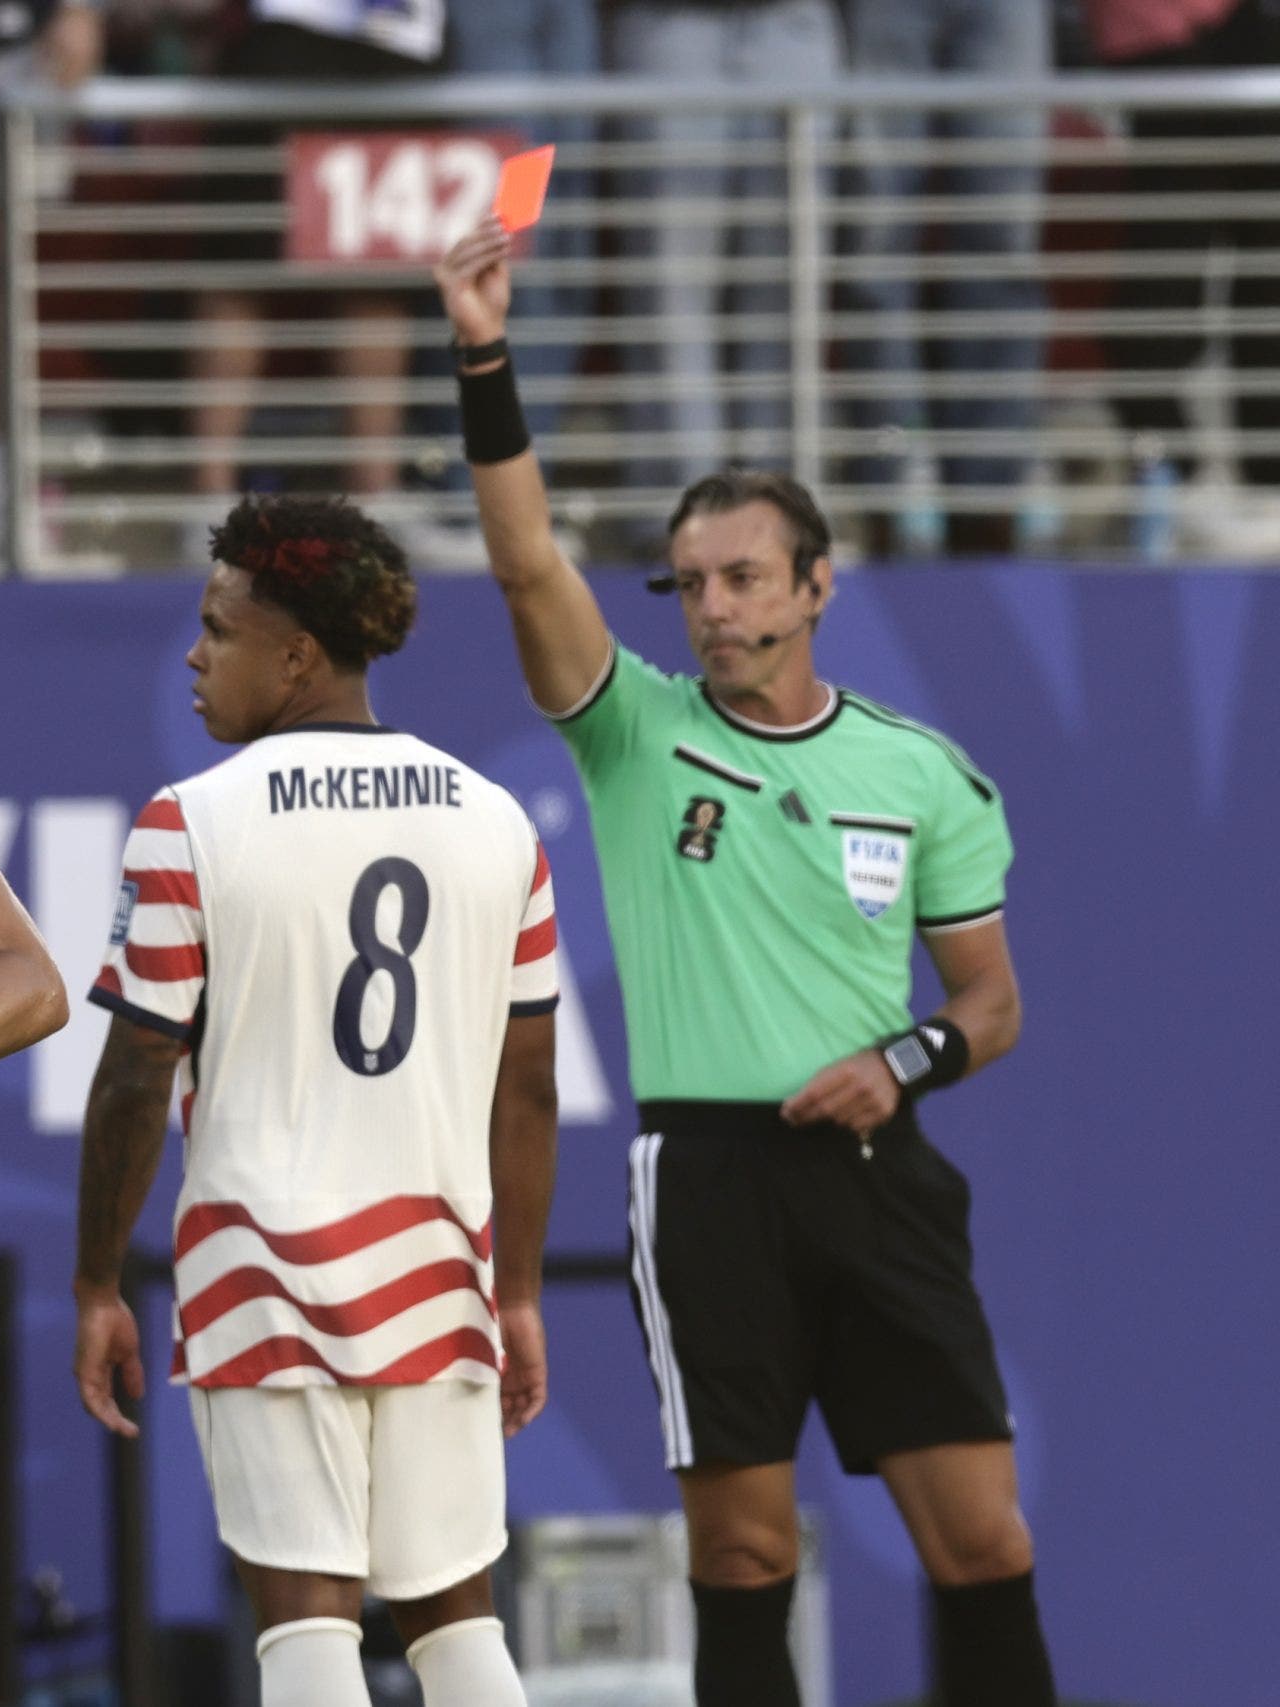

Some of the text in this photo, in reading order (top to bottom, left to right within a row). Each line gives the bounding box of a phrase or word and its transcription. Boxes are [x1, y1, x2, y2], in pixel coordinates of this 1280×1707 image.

[317, 140, 497, 254] 142
[269, 765, 462, 815] McKENNIE
[332, 856, 430, 1077] 8
